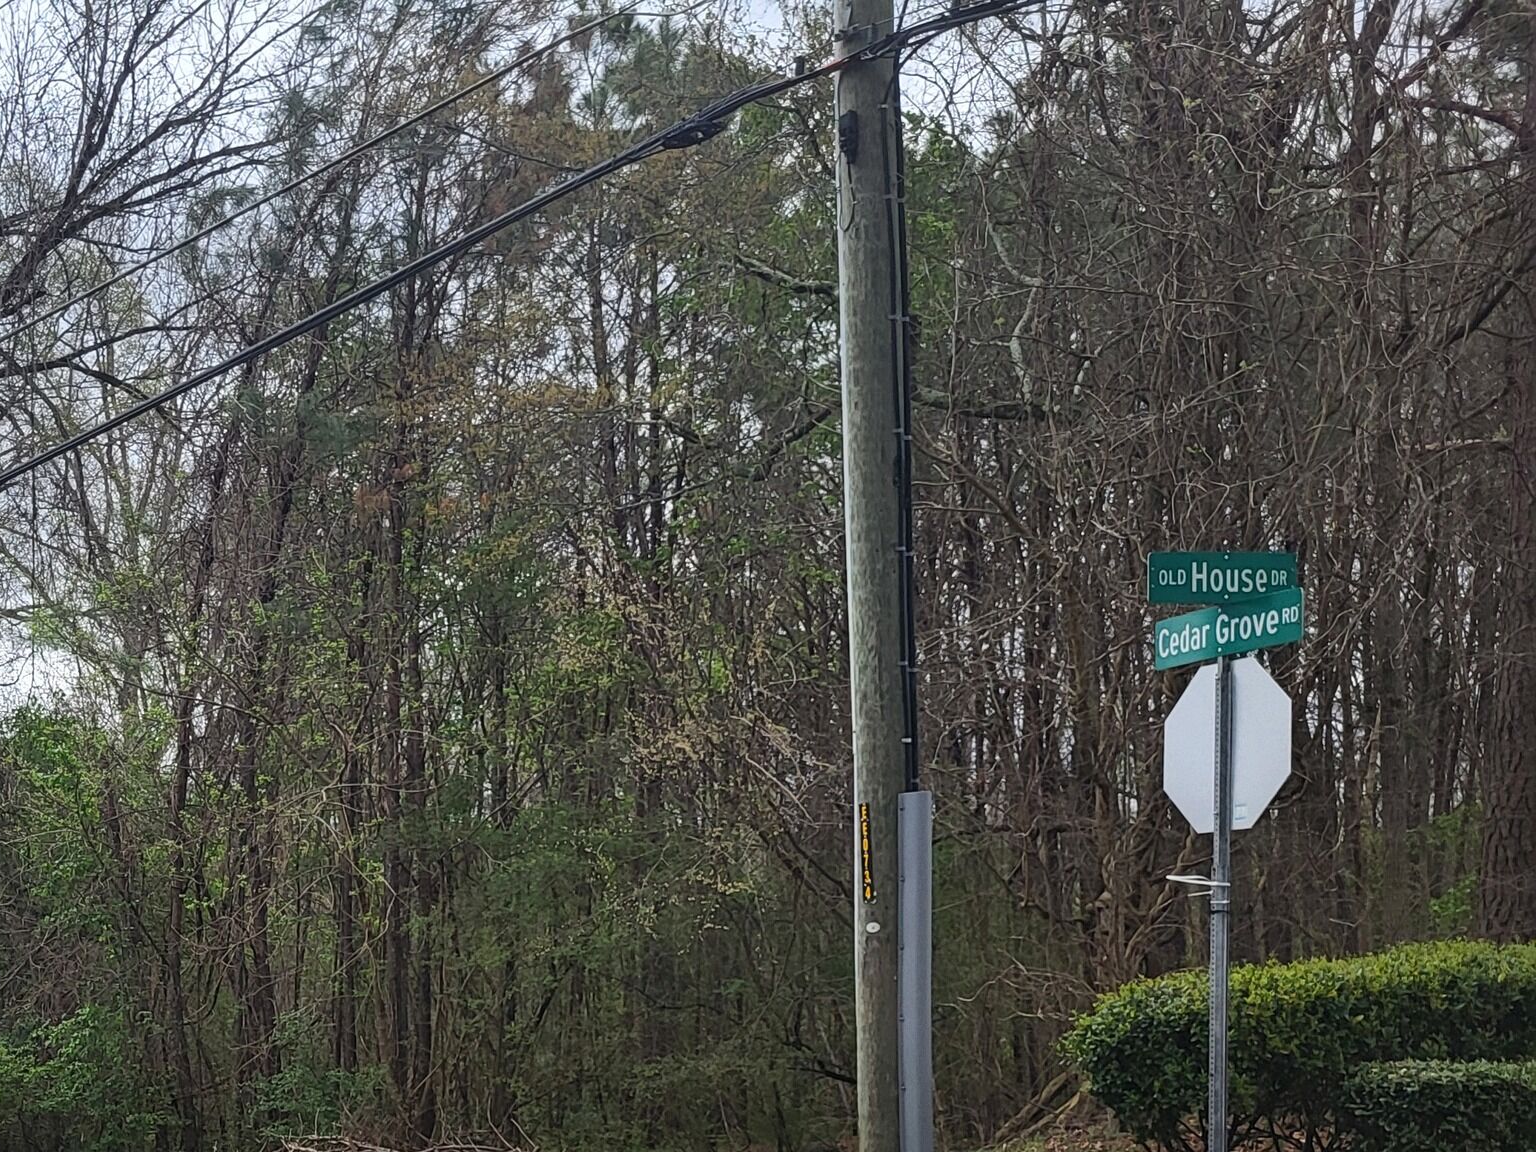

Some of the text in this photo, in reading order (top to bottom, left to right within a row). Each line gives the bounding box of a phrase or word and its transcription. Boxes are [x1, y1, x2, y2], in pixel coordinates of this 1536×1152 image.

[1158, 561, 1288, 593] OLD House DR
[1158, 606, 1299, 659] Cedar Grove RD
